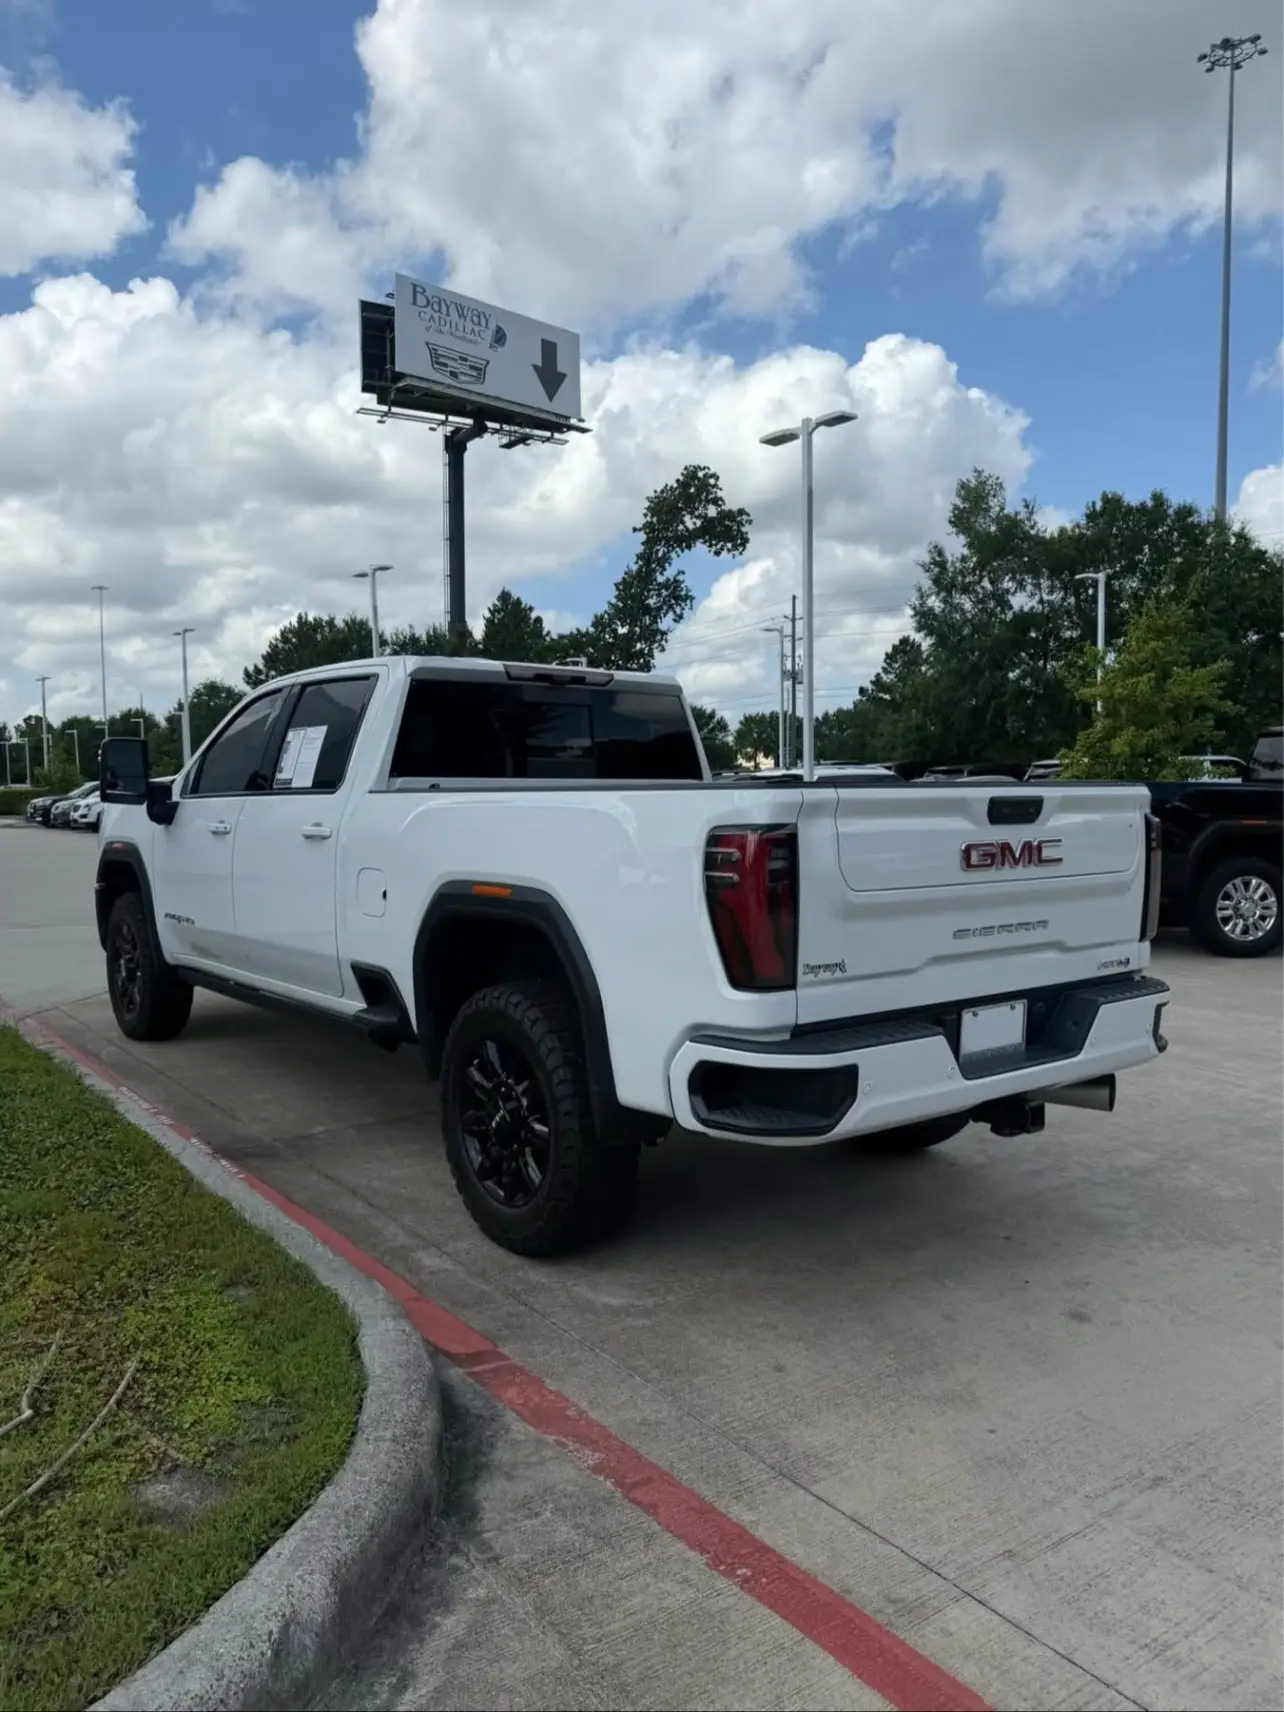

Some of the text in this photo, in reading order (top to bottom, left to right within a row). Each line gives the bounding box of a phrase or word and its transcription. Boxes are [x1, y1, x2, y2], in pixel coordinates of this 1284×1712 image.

[410, 282, 492, 330] Bayway
[418, 310, 487, 341] CADILLAC
[960, 837, 1063, 872] GMC
[952, 919, 1050, 940] SIERRA
